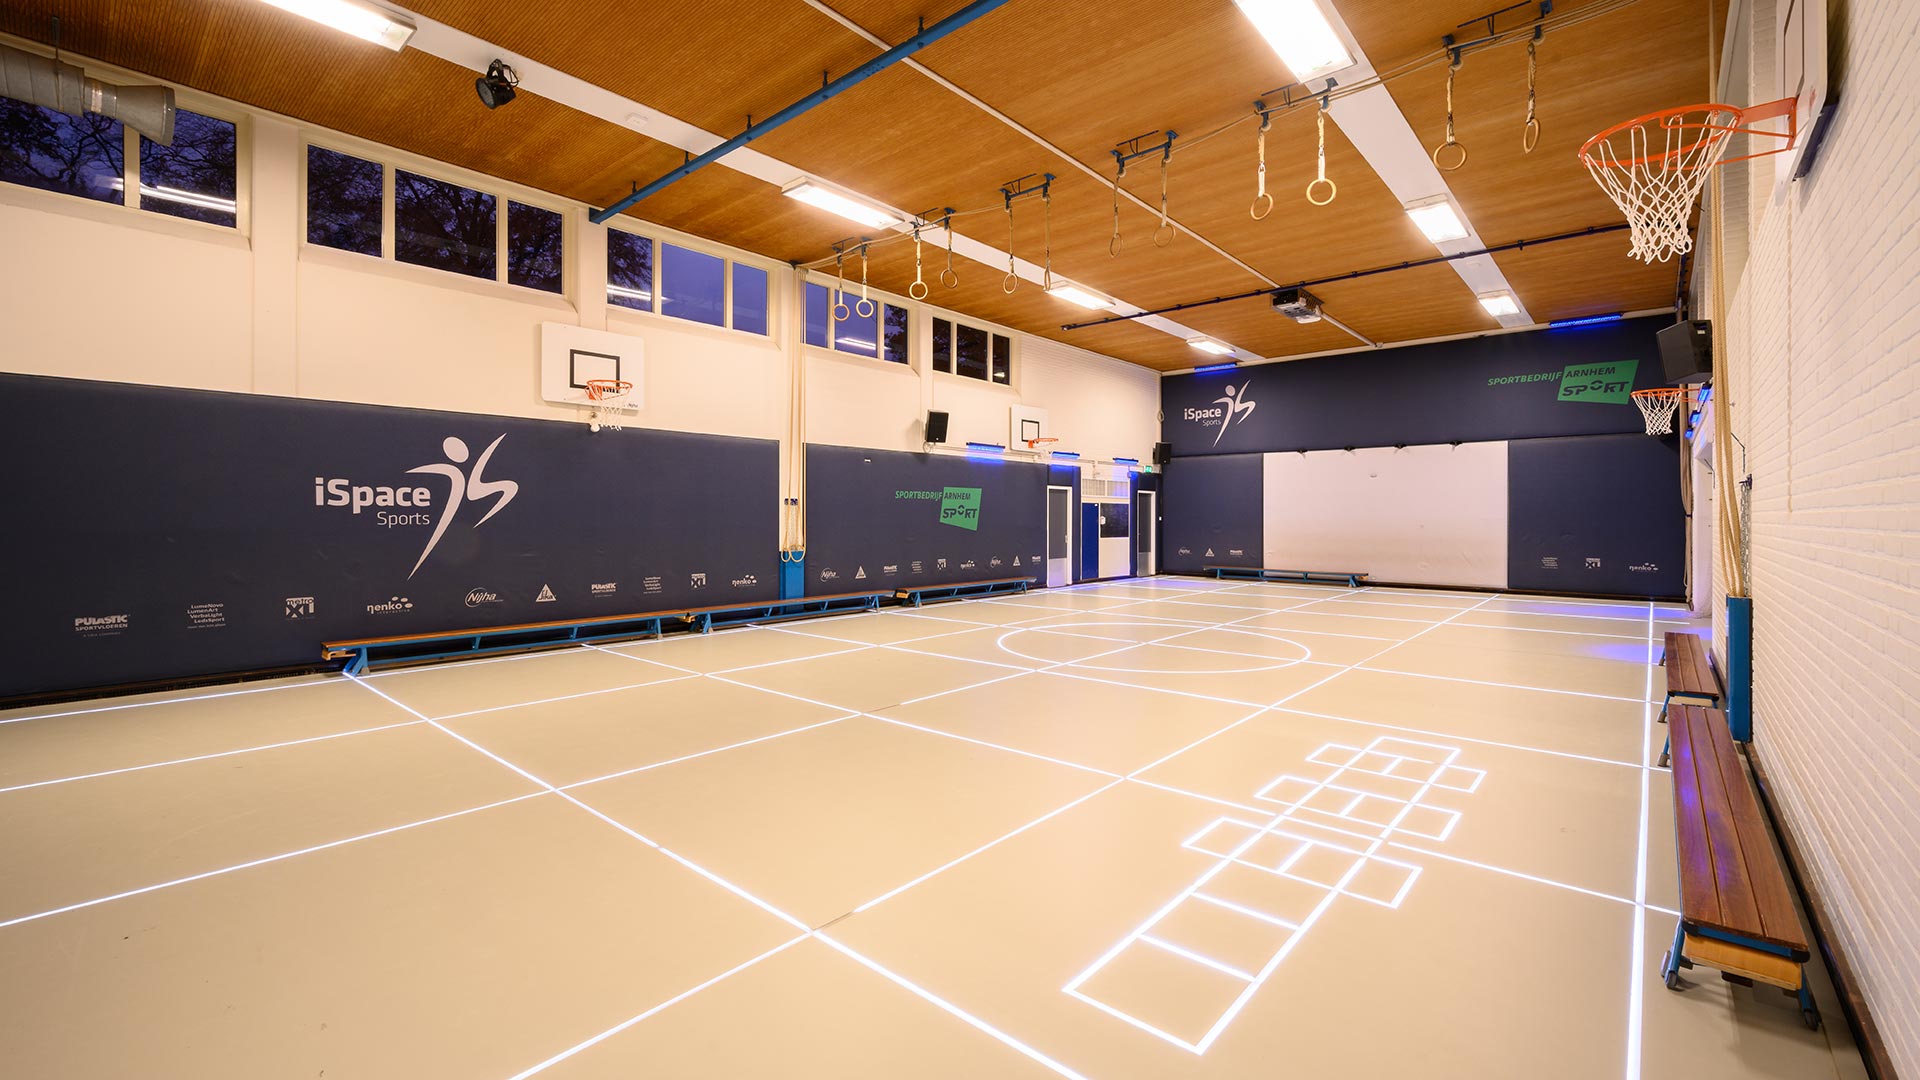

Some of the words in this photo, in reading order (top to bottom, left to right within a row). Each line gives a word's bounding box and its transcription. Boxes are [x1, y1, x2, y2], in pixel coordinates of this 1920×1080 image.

[1487, 371, 1562, 386] SPORTBEDRIJF
[1565, 366, 1616, 378] ARNHEM
[1562, 380, 1630, 396] SPORT
[1184, 408, 1221, 421] iSpace
[1202, 419, 1221, 427] Sports
[315, 477, 431, 514] iSpace
[895, 490, 942, 501] SPORTBEDRIJF
[944, 492, 971, 500] ARNHEM
[942, 504, 977, 519] SPORT
[377, 511, 430, 529] Sports
[75, 614, 127, 626] PULASTIC
[75, 623, 128, 631] SPORTVLOEREN
